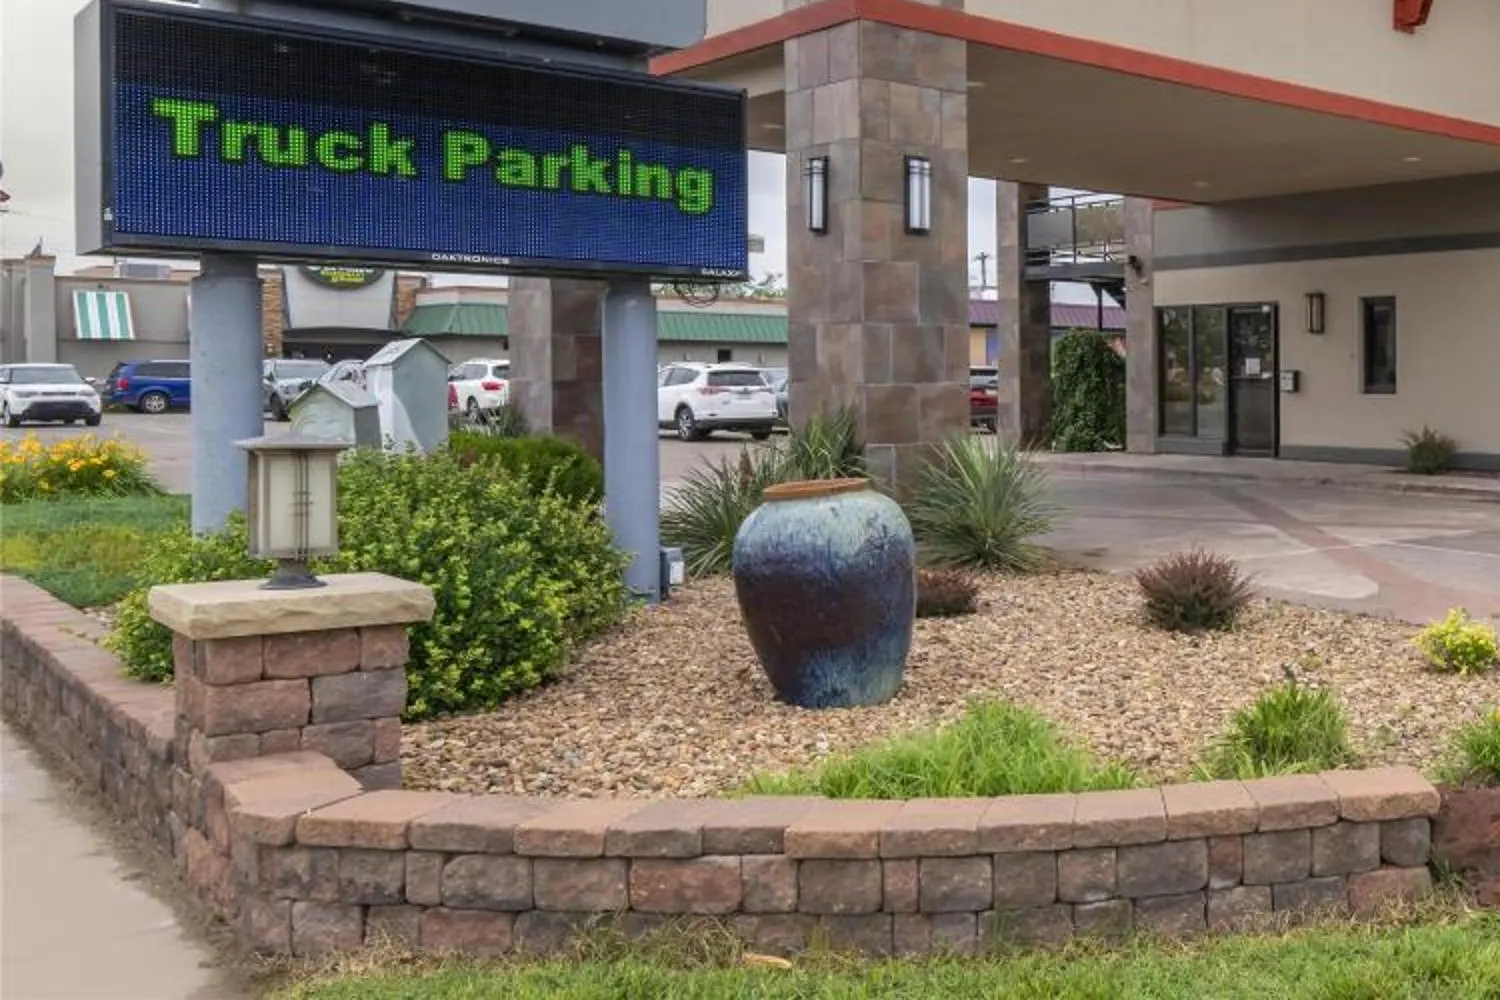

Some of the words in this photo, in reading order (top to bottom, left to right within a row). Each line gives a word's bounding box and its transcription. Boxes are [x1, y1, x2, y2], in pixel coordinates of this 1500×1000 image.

[153, 98, 416, 178] Truck
[444, 129, 713, 214] Parking
[431, 252, 510, 265] DAKTRONICS
